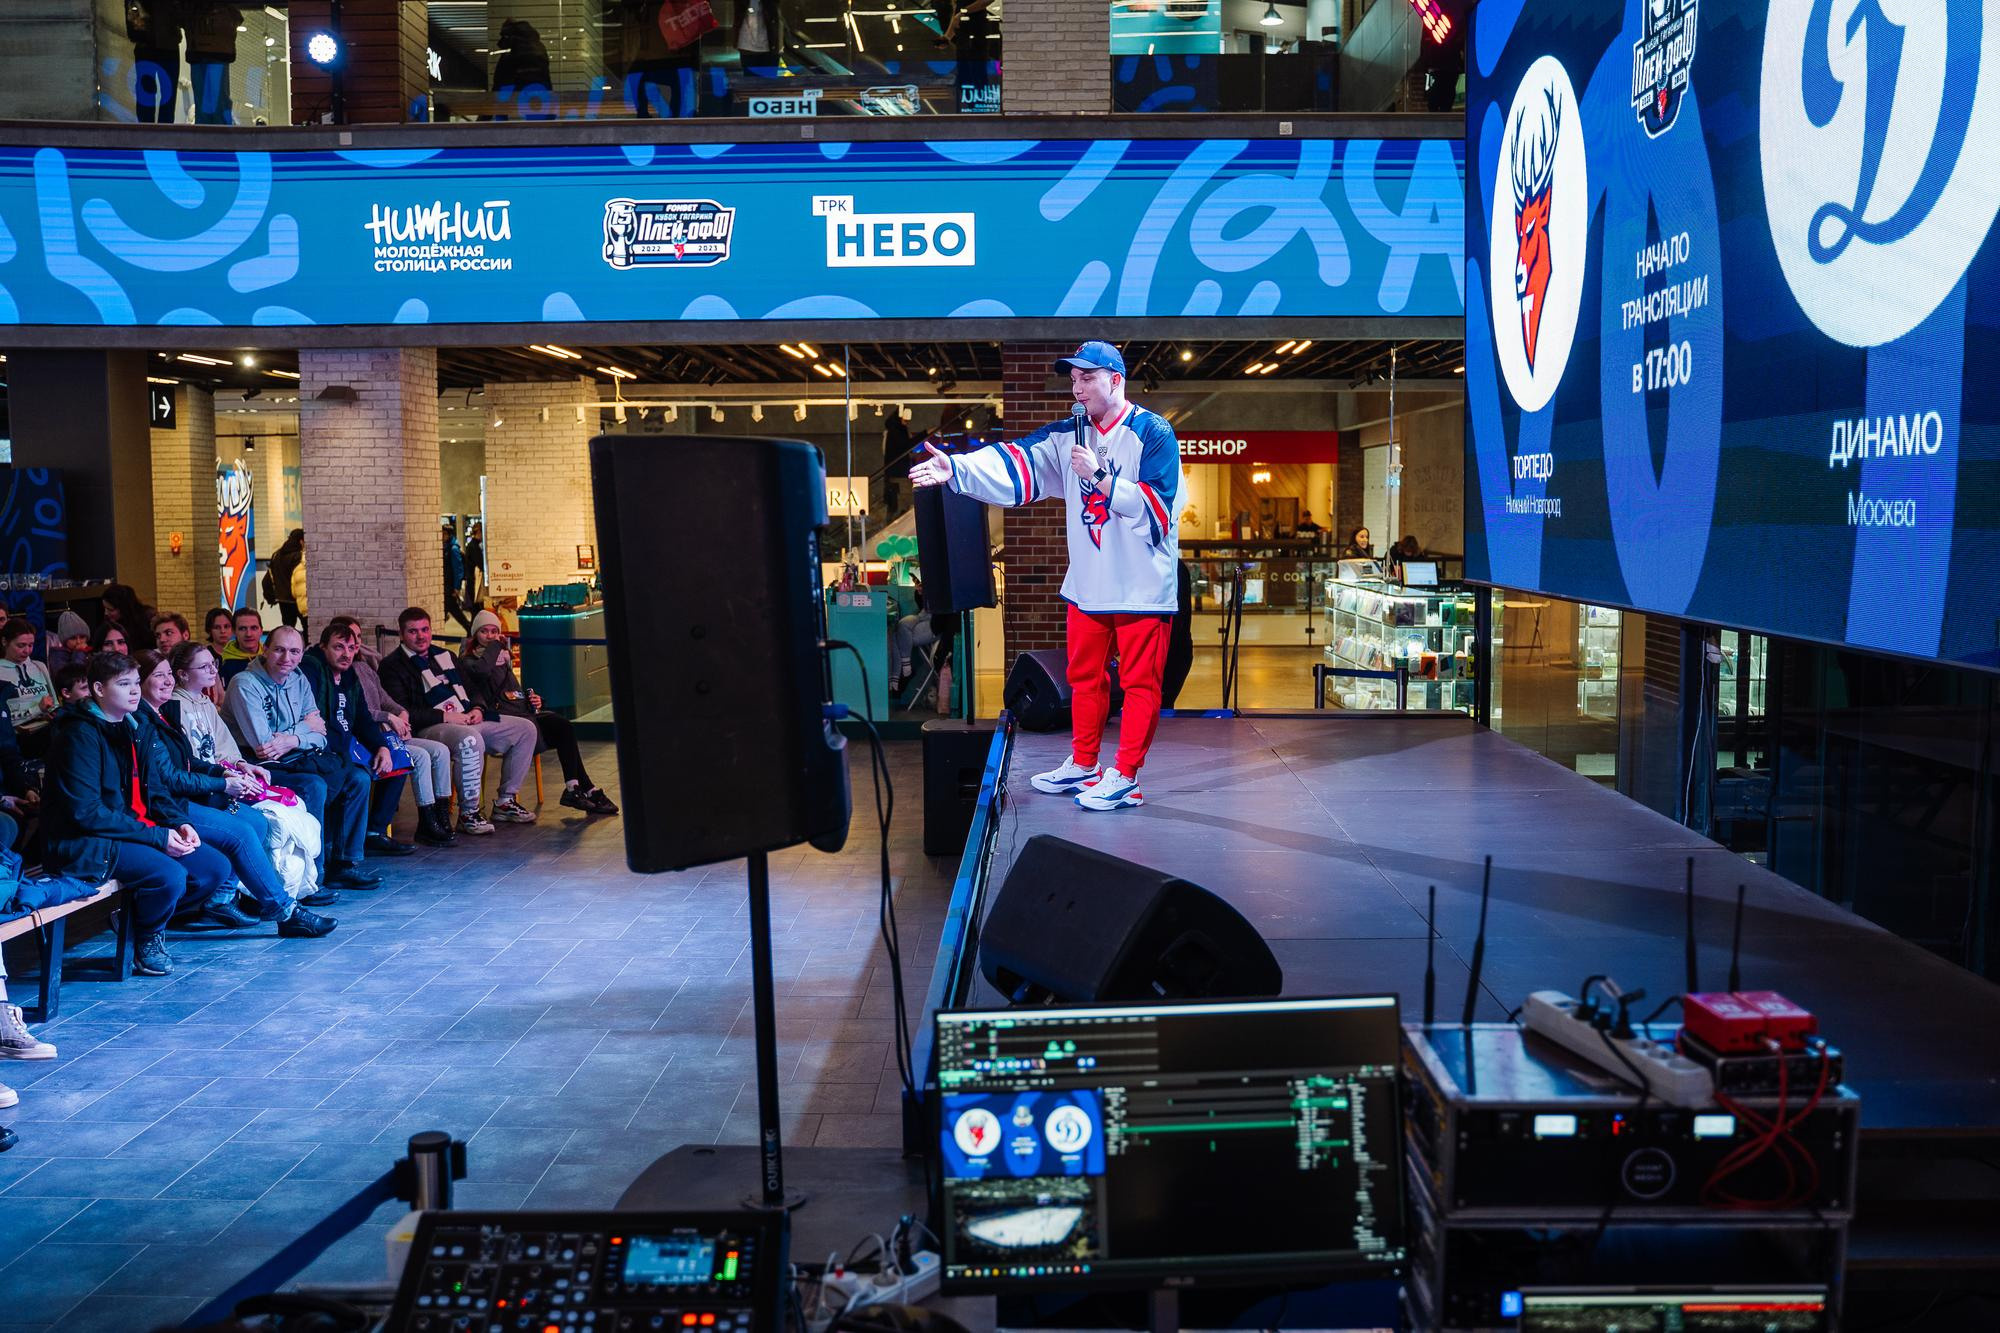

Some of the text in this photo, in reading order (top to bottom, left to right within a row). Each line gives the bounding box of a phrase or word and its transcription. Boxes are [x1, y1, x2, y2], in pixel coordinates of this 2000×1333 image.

[655, 213, 713, 221] КУБОК ГАГАРИНА
[820, 200, 847, 212] ТРК
[374, 243, 484, 260] МОЛОДЁЖНАЯ
[837, 222, 966, 257] НЕБО
[374, 258, 512, 273] СТОЛИЦА РОССИИ
[1636, 231, 1690, 279] НАЧАЛО
[1621, 274, 1708, 331] ТРАНСЛЯЦИИ
[1645, 340, 1692, 391] 17:00
[1178, 440, 1247, 455] EESHOP
[1829, 411, 1943, 468] ДИНАМО
[1513, 453, 1553, 482] ТОРПЕДО
[1505, 494, 1561, 519] Нижний Новгород
[1848, 490, 1917, 527] Москва
